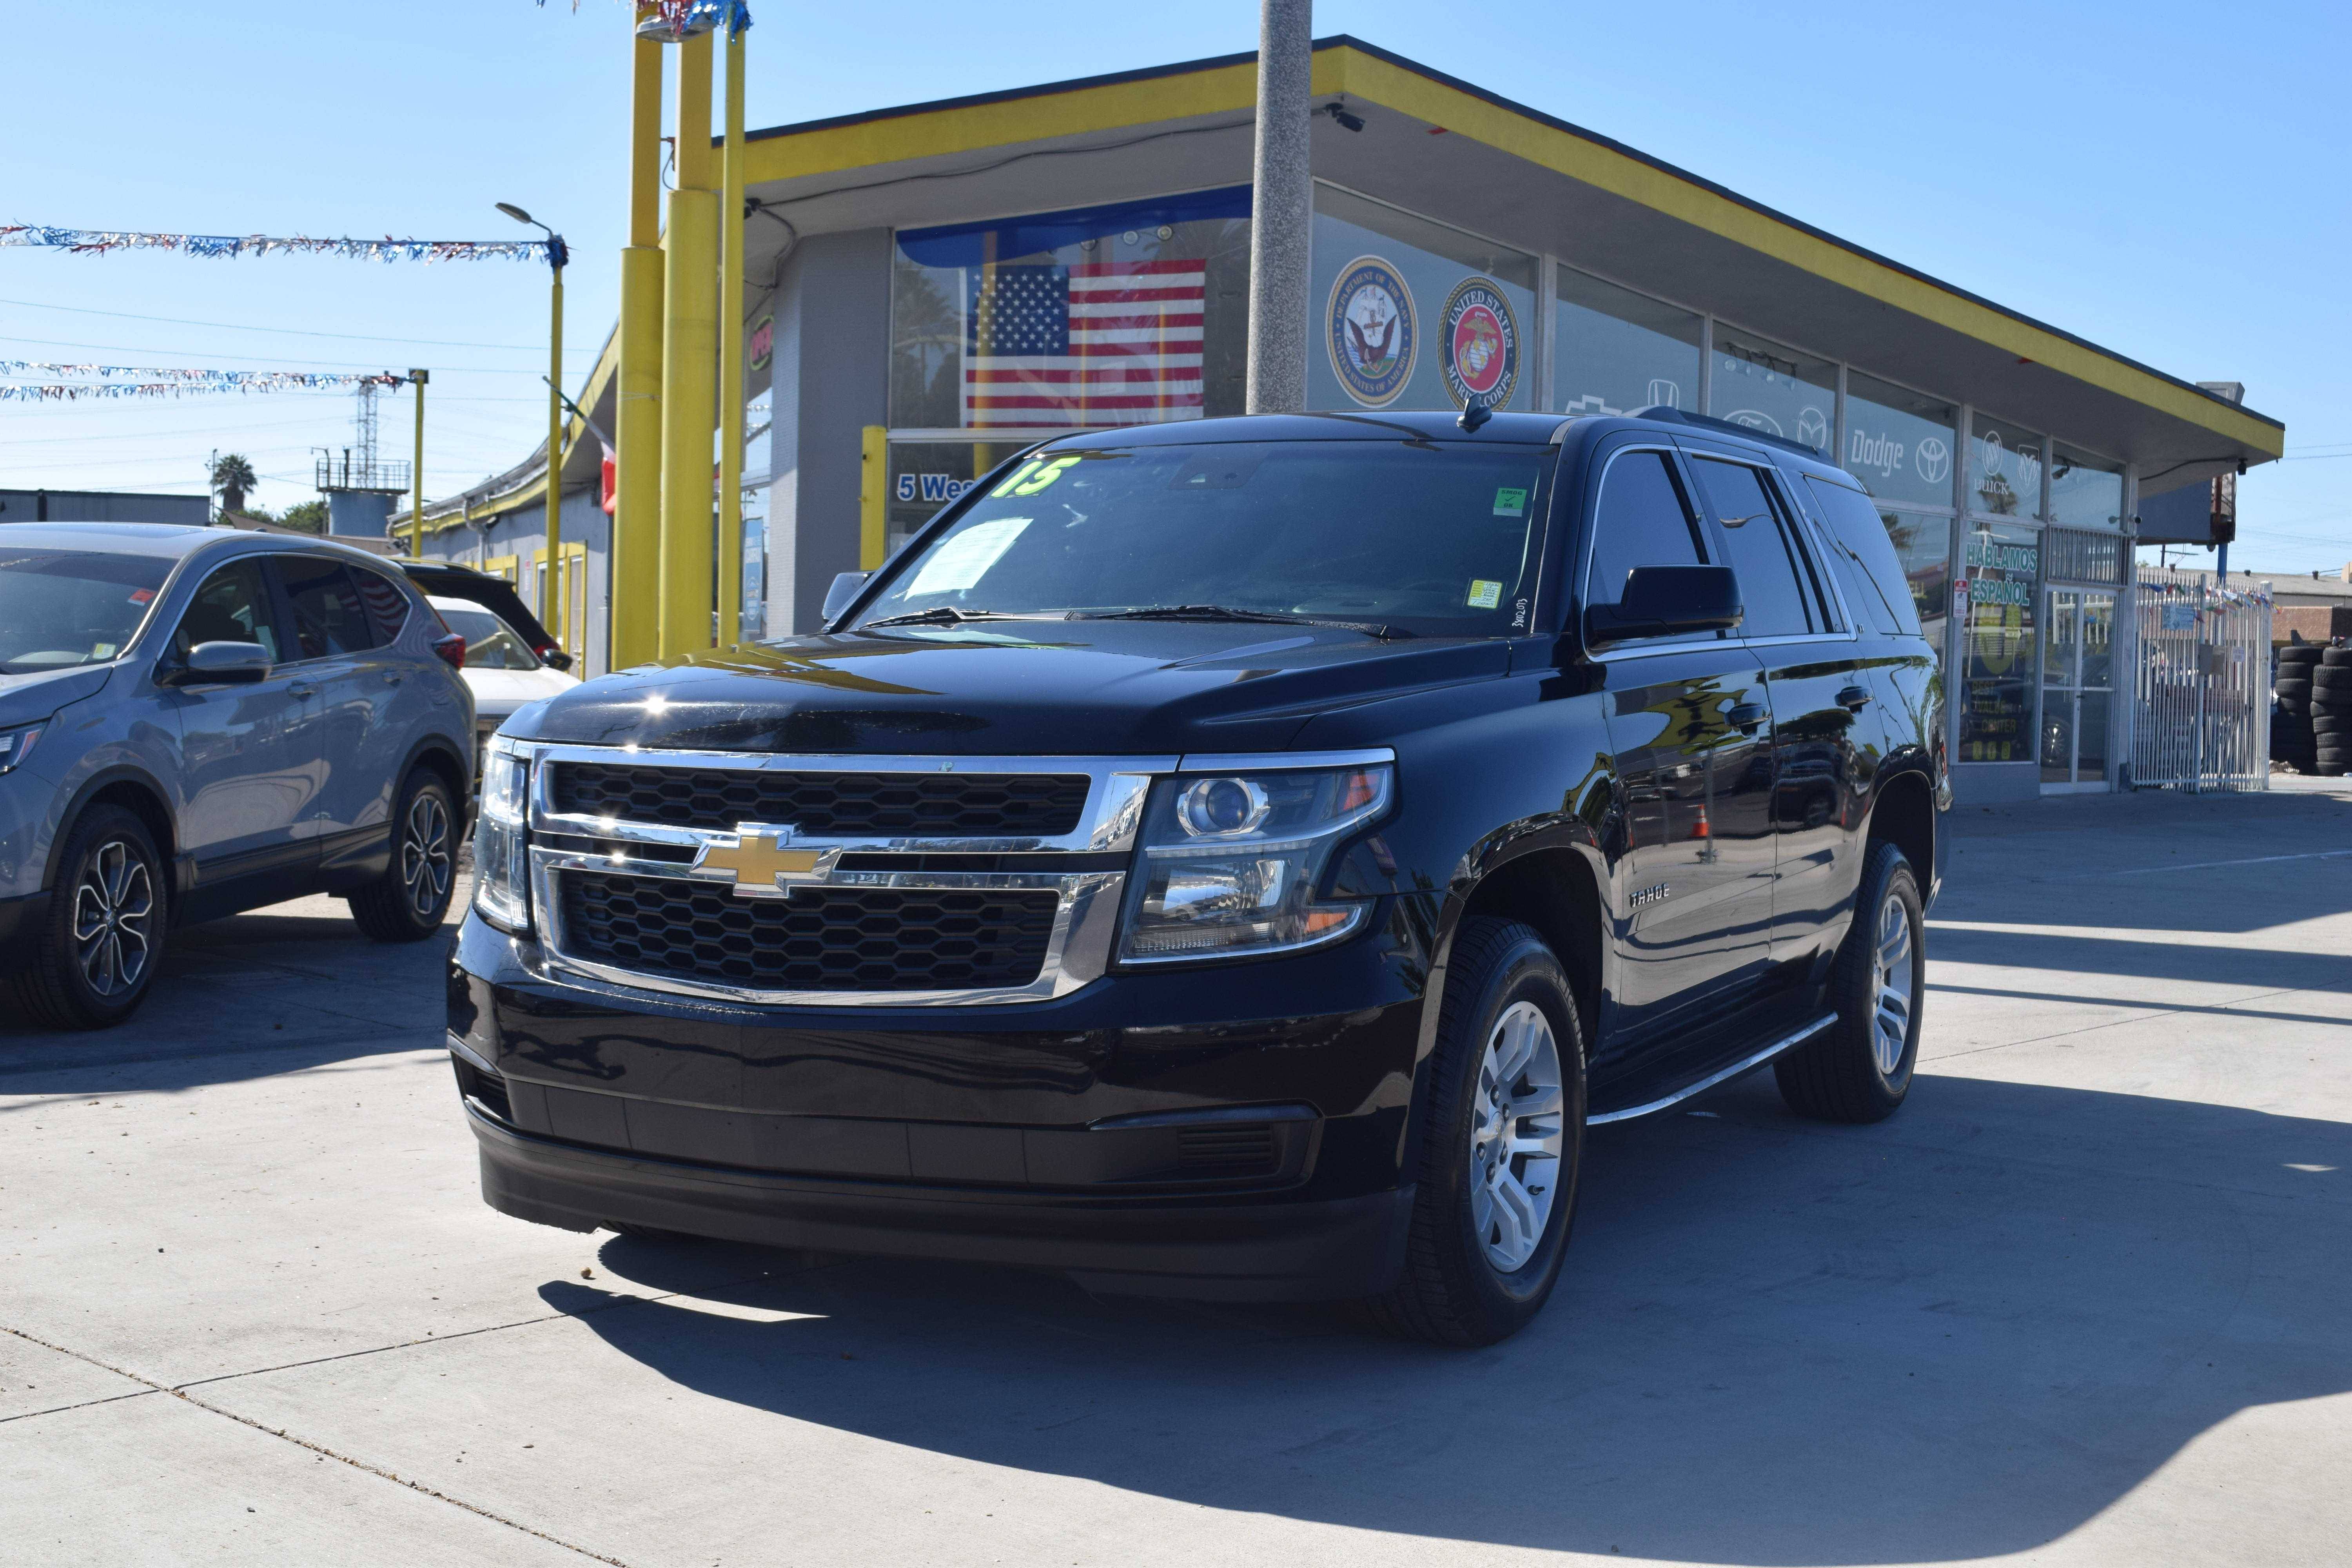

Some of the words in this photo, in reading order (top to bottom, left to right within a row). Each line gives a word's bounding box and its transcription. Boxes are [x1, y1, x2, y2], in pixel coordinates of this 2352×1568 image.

[1337, 272, 1373, 318] DEPARTMENT
[1376, 273, 1386, 284] OF
[1388, 281, 1401, 301] THE
[1399, 301, 1410, 328] NAVY
[1449, 291, 1485, 326] UNITED
[1486, 295, 1513, 348] STATES
[1334, 332, 1351, 375] UNITED
[1349, 373, 1374, 392] STATES
[1376, 381, 1386, 392] OF
[1387, 347, 1409, 387] AMERICA
[1447, 364, 1485, 407] MARI
[1484, 370, 1512, 407] CORPS
[1851, 430, 1904, 477] Dodge
[897, 474, 916, 501] 5
[991, 457, 1081, 497] 15
[1973, 478, 2009, 495] BUICK
[1966, 543, 2037, 572] HABLAMOS
[1971, 573, 2029, 606] ESPAÑOL
[1512, 599, 1528, 627] 3802073
[1629, 882, 1670, 908] TAHOE
[1559, 975, 1586, 1069] MICHELIN
